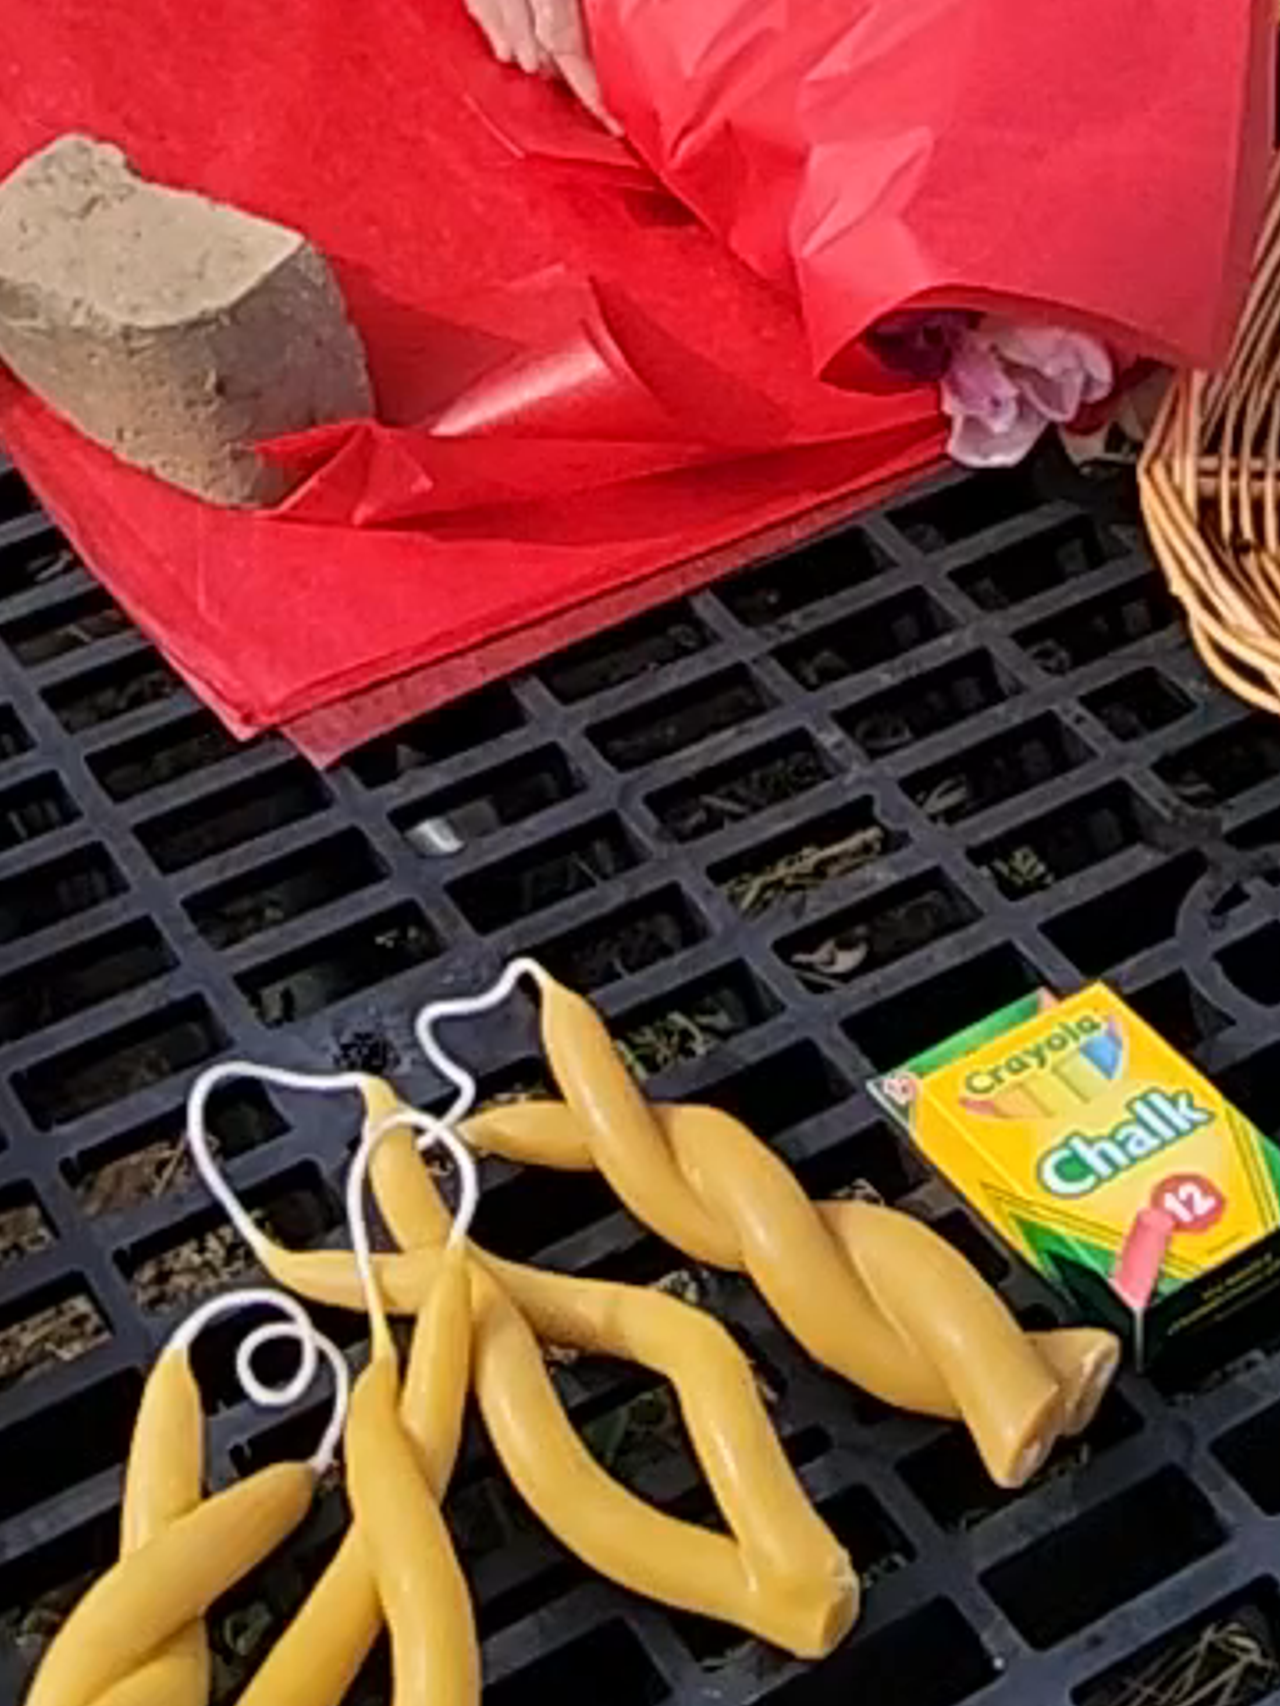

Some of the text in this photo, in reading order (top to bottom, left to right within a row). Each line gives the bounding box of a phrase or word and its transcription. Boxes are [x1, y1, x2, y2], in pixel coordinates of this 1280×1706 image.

[966, 1015, 1102, 1094] Crayola
[1037, 1088, 1216, 1198] Chalk
[1164, 1182, 1217, 1224] 12
